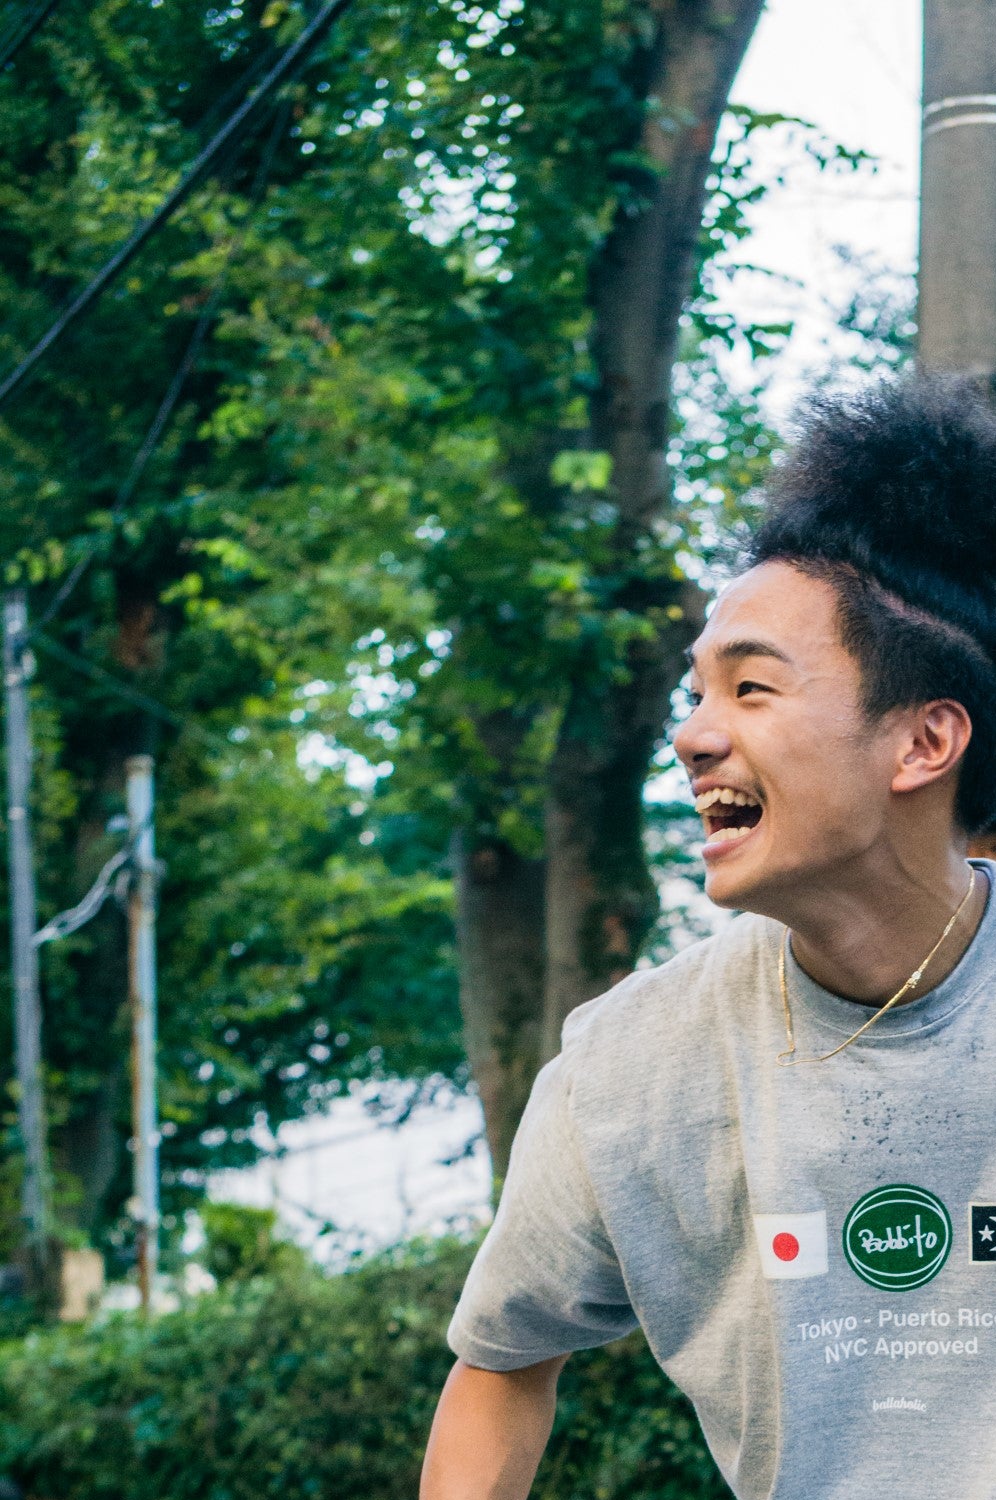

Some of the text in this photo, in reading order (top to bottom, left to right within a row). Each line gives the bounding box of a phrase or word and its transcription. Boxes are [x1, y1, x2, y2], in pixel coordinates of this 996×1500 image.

[858, 1214, 938, 1258] Bobbito
[797, 1315, 857, 1341] Tokyo
[878, 1309, 950, 1327] Puerto
[825, 1337, 978, 1364] NYC Approved
[872, 1397, 927, 1412] ballaholic
